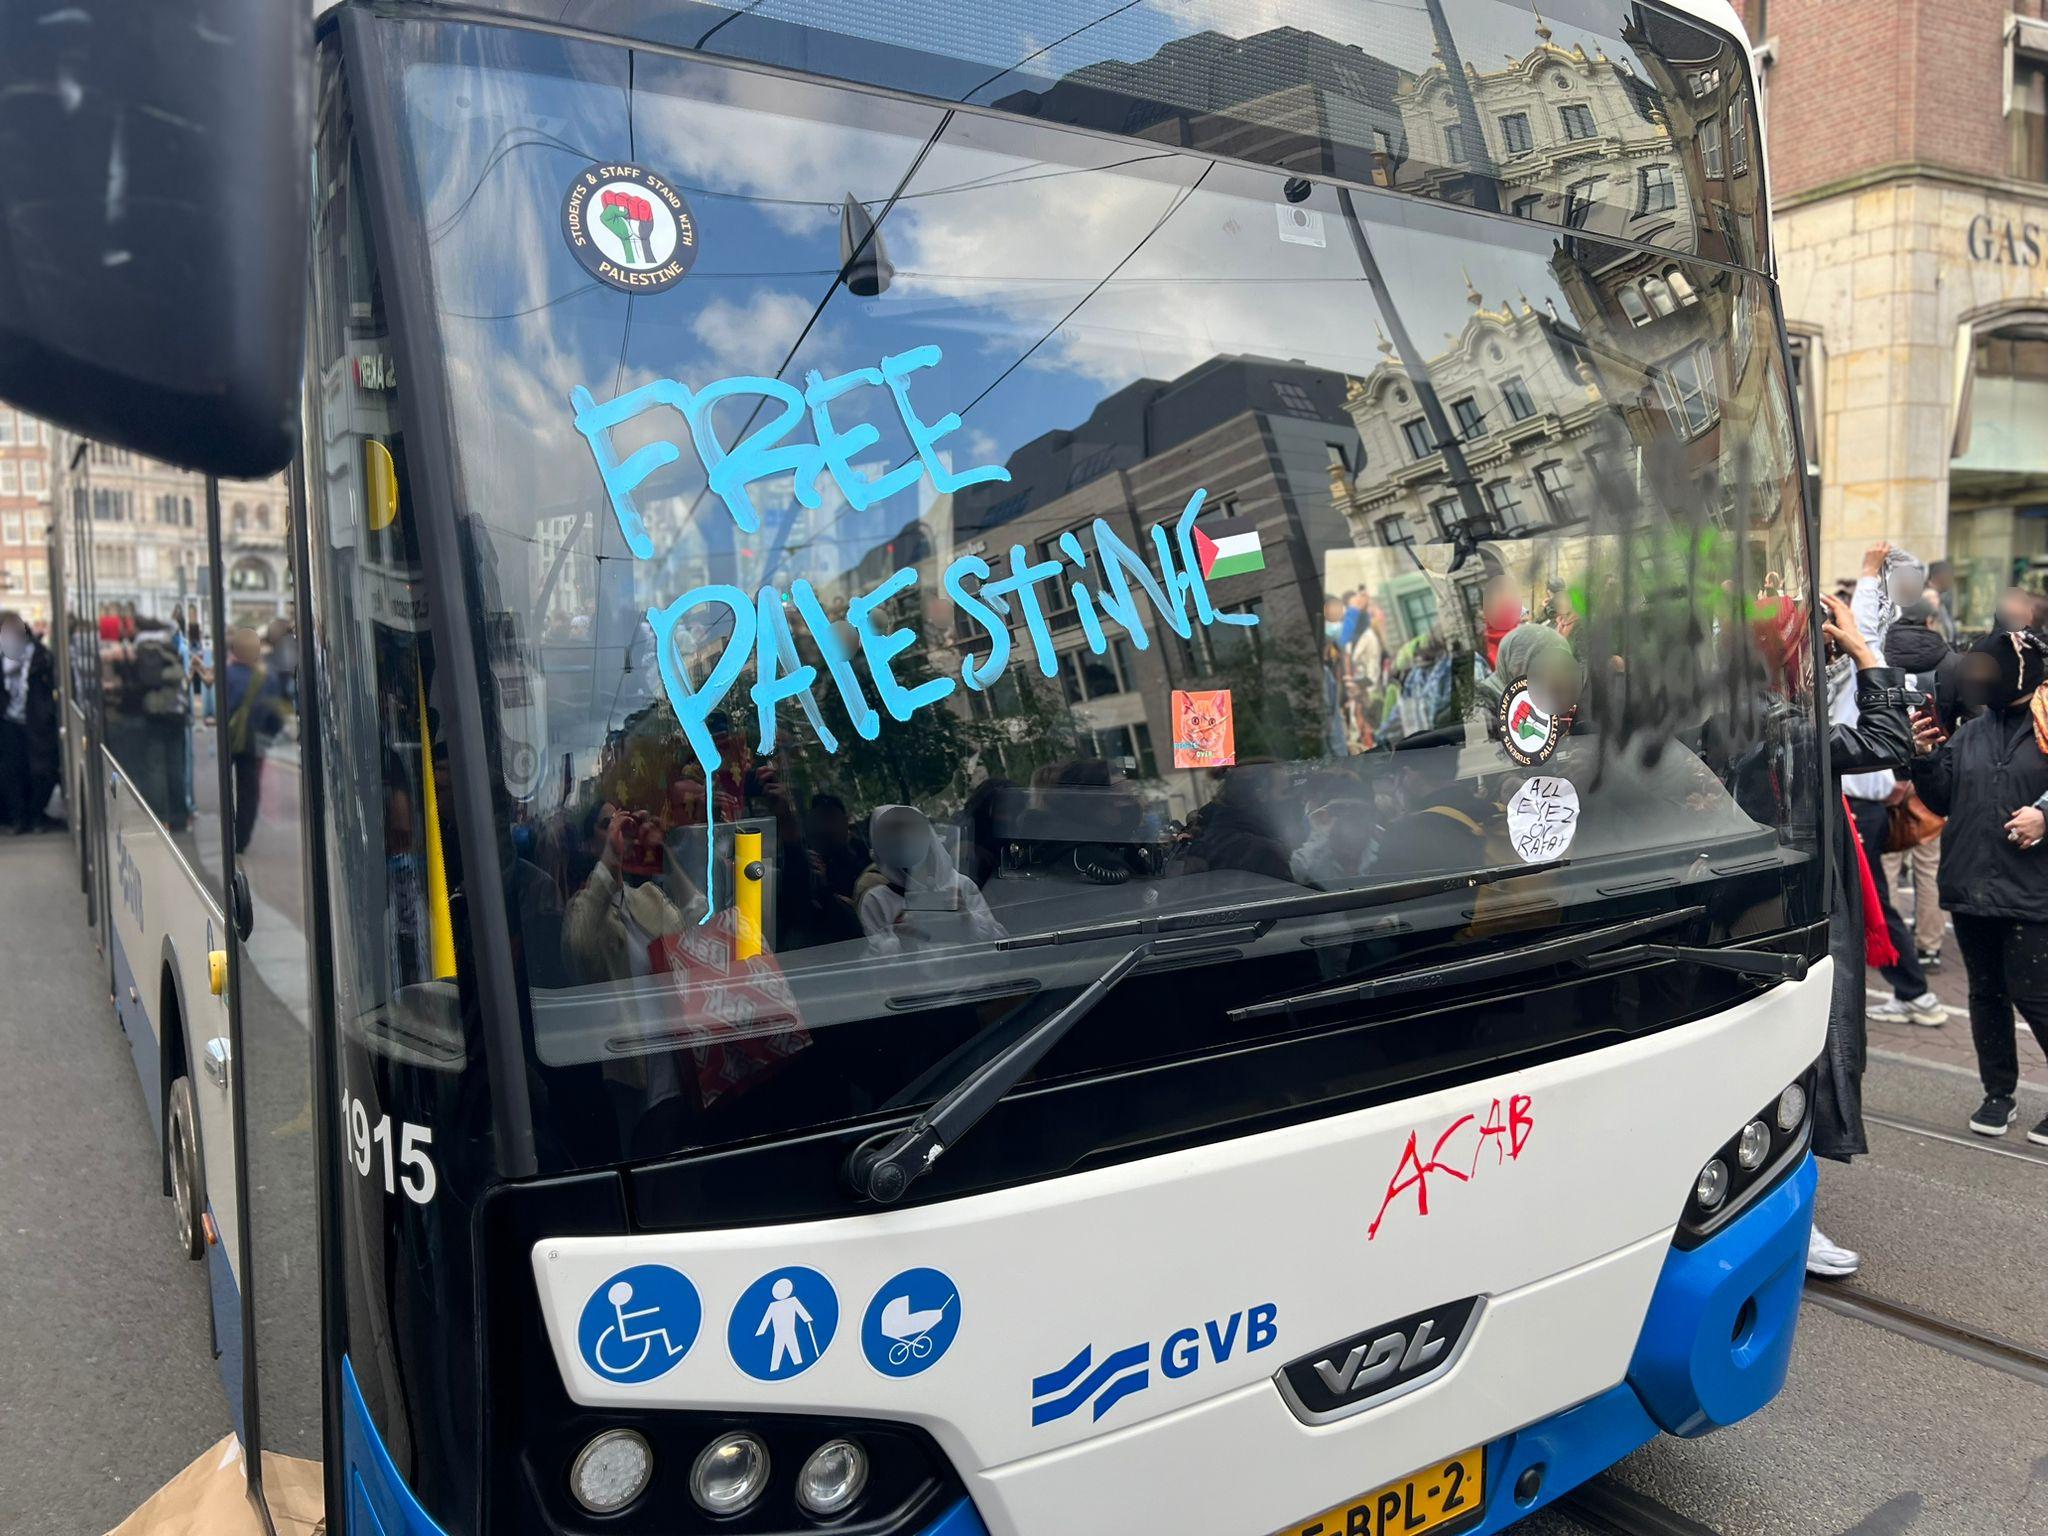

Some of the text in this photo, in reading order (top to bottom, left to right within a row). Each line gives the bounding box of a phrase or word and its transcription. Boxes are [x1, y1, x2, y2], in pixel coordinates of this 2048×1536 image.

[568, 166, 693, 247] STUDENTS & STAFF STAND WITH
[598, 260, 684, 286] PALESTINE
[571, 344, 1012, 560] FREE
[1503, 735, 1531, 765] STUDENTS
[1540, 713, 1559, 760] PALESTIN
[1530, 778, 1561, 798] ALL
[342, 1087, 437, 1205] 1915
[1367, 1094, 1534, 1240] ACAB
[1160, 1302, 1279, 1379] GVB
[1313, 1319, 1446, 1395] VDL
[1301, 1461, 1465, 1536] -BPL-2
